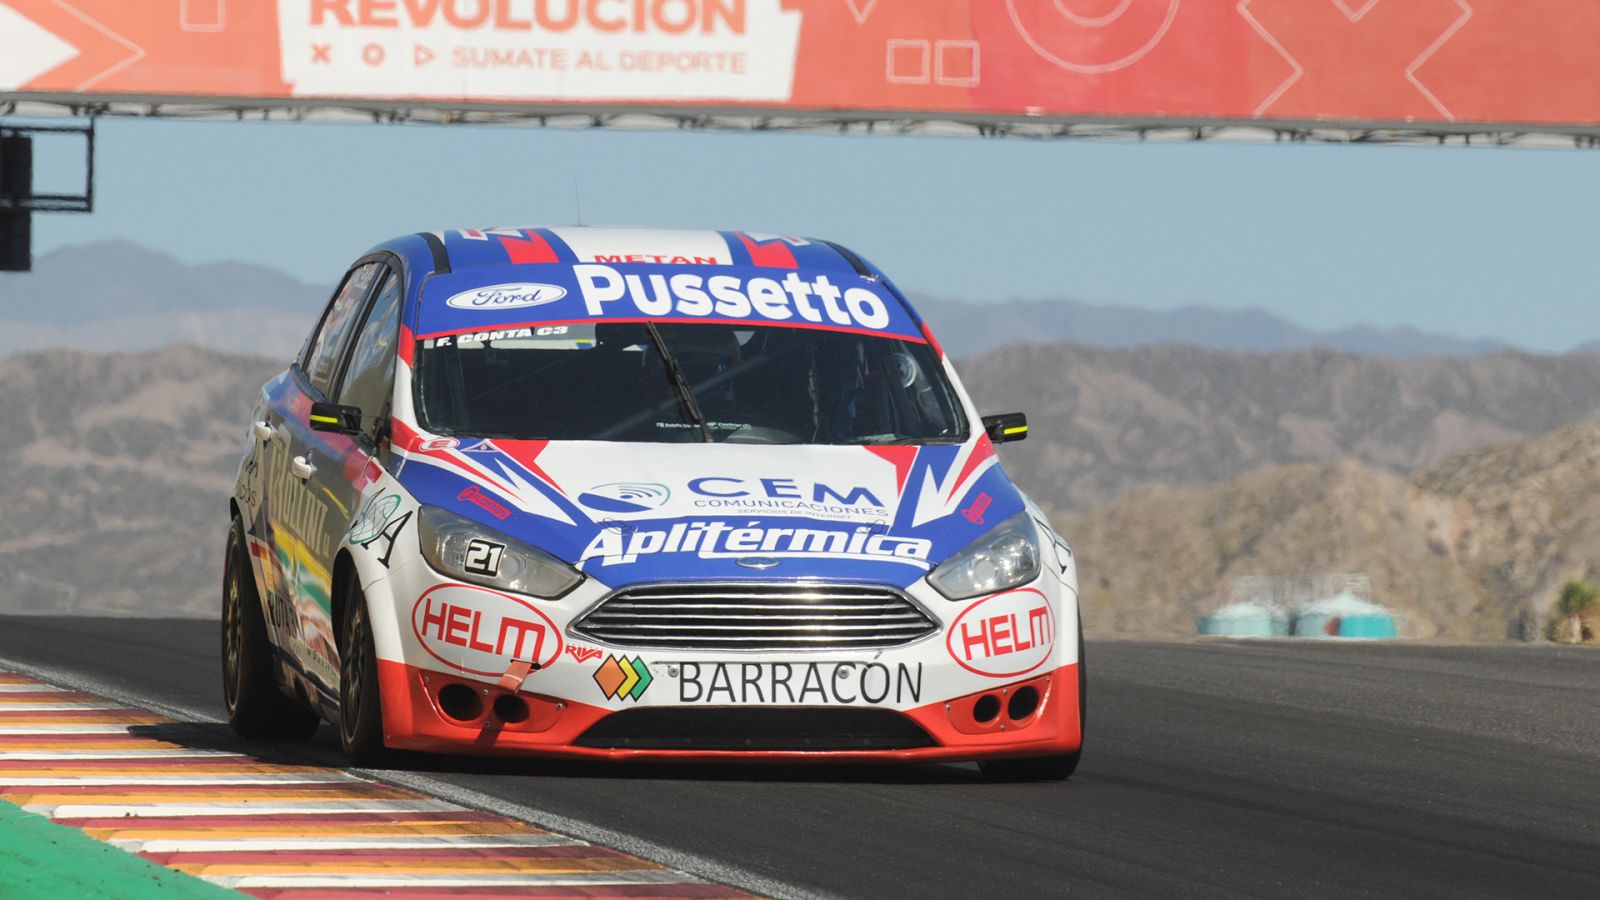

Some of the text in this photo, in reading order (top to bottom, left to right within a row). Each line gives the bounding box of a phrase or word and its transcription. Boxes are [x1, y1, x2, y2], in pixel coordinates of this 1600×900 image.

[452, 46, 746, 75] SUMATE AL DEPORTE
[472, 286, 541, 306] Ford
[572, 264, 890, 330] Pussetto
[436, 325, 569, 347] F. CONTA C3
[687, 477, 885, 507] CEM
[694, 499, 889, 517] COMUNICACIONES
[805, 511, 852, 519] INTERNET
[467, 542, 497, 572] 21
[575, 520, 933, 571] Aplitérmica
[421, 598, 546, 663] HELM
[960, 606, 1051, 661] HELM
[565, 644, 603, 663] RIVA
[678, 650, 922, 703] BARRACÓN
